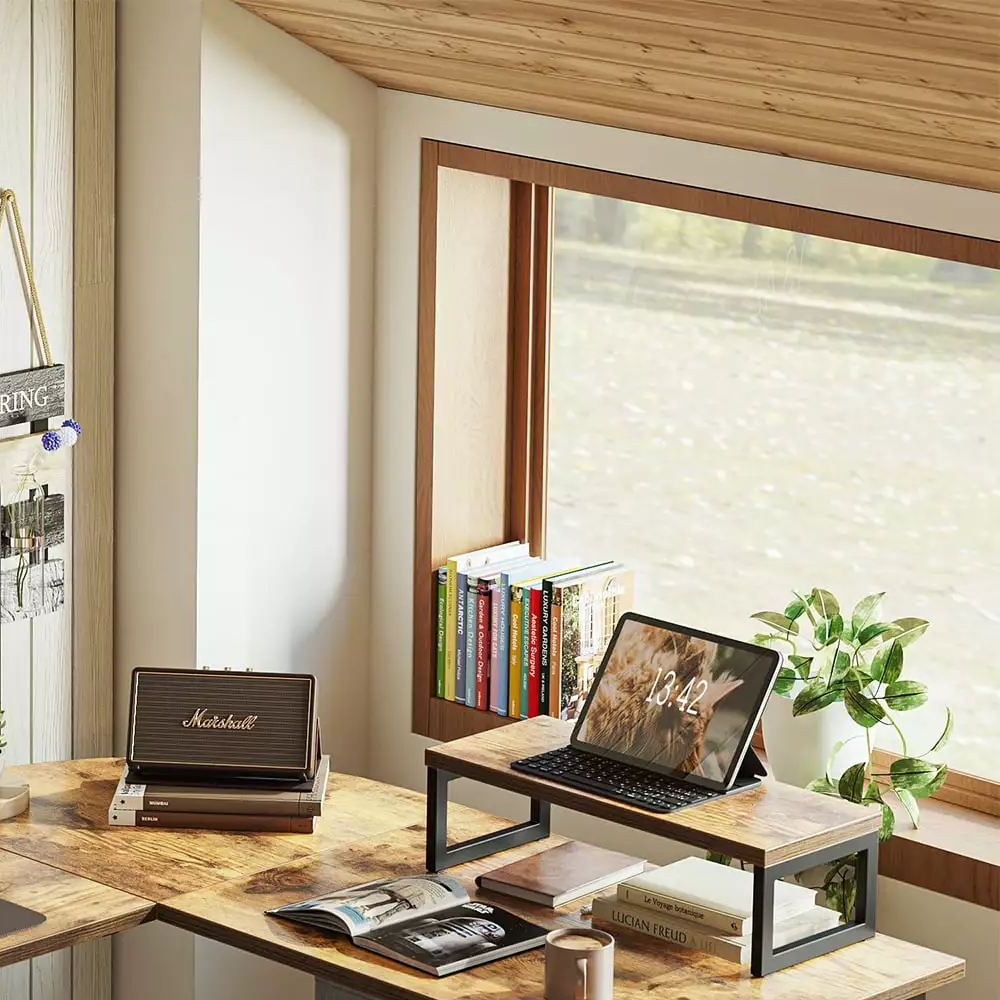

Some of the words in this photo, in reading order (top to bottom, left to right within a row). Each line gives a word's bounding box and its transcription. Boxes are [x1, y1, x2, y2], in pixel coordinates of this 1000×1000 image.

[467, 597, 475, 628] Kitchen
[530, 613, 538, 645] Aestetic
[529, 646, 538, 678] Surgery
[541, 625, 549, 667] GARDENS
[645, 667, 708, 715] 13:42
[182, 708, 258, 730] Marshall
[643, 896, 651, 904] Le
[652, 898, 674, 911] Voyage
[674, 904, 704, 919] botanique
[612, 909, 650, 932] LUCIAN
[653, 923, 687, 944] FREUD
